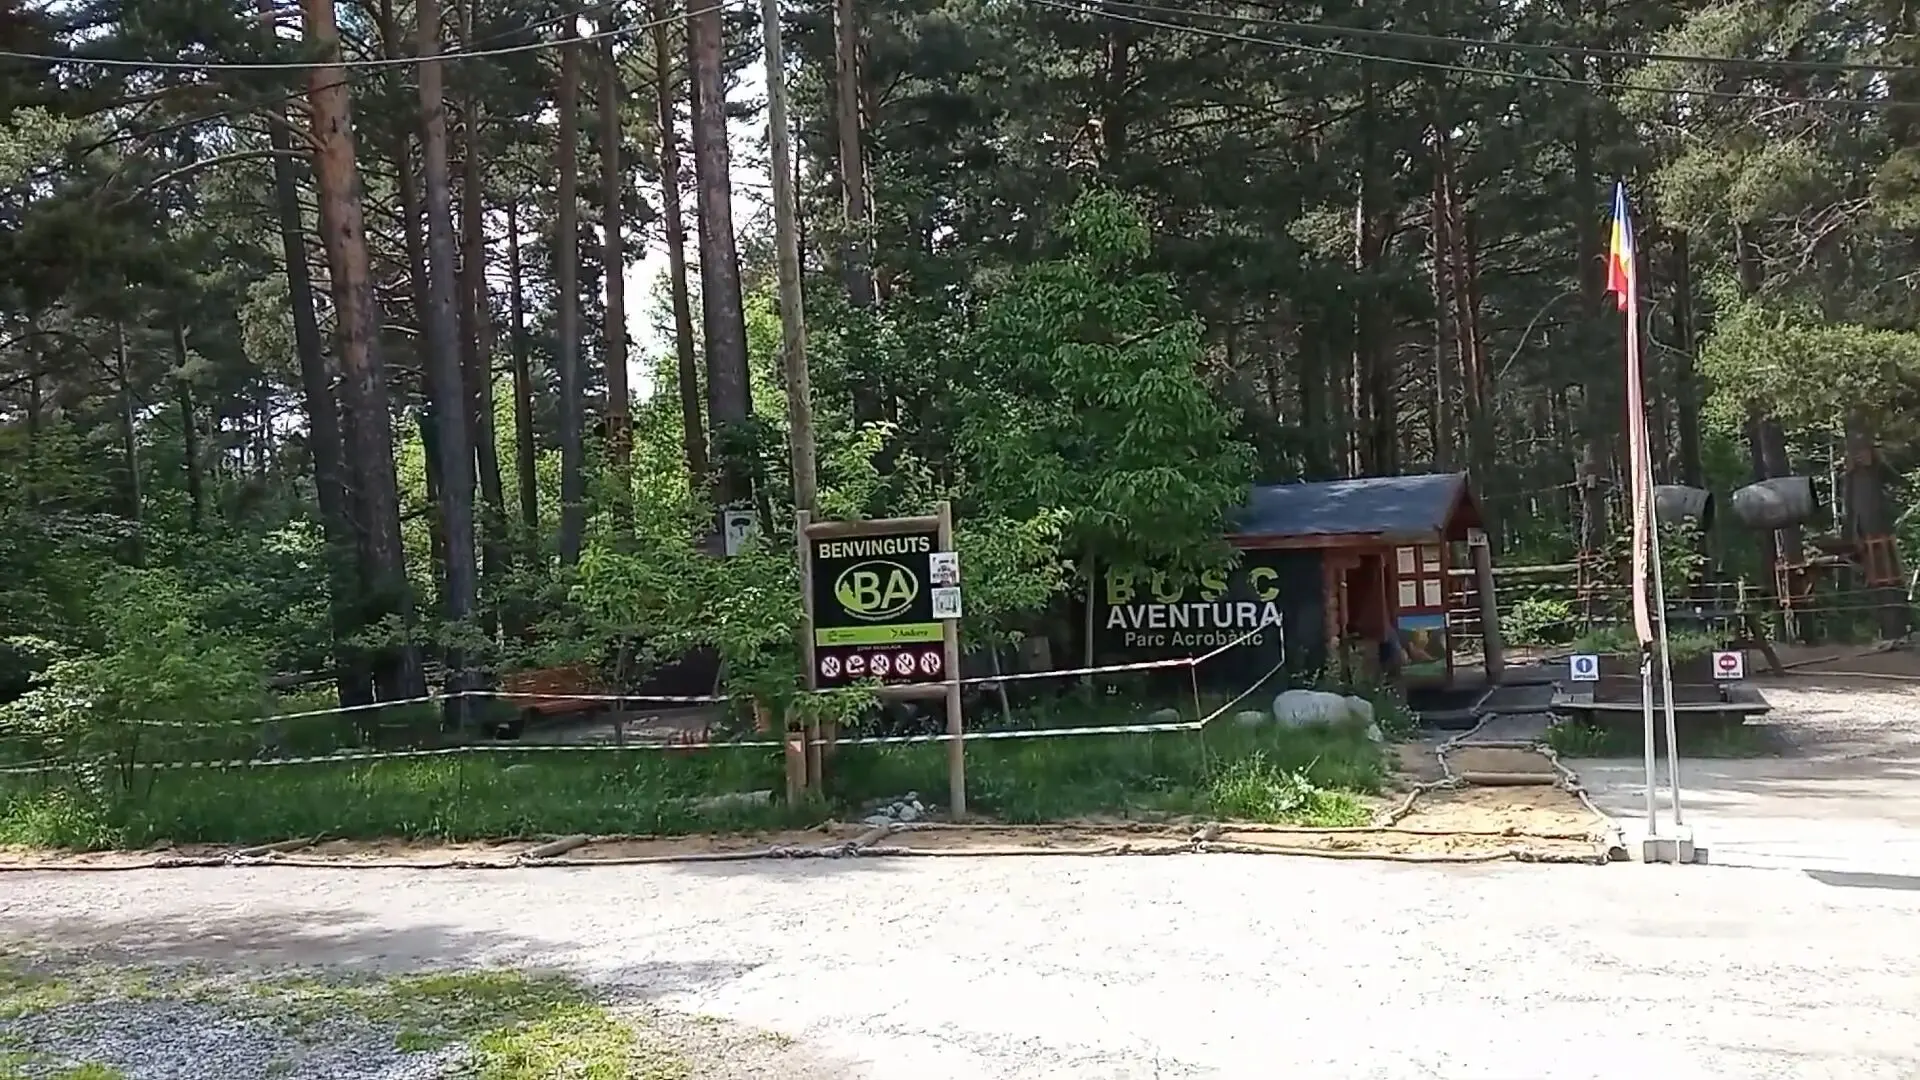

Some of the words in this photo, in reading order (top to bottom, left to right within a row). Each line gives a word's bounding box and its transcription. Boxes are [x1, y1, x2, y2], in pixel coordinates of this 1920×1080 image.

[819, 537, 930, 558] BENVINGUTS
[853, 569, 912, 609] BA
[1106, 601, 1283, 629] AVENTURA
[1124, 631, 1165, 648] Parc
